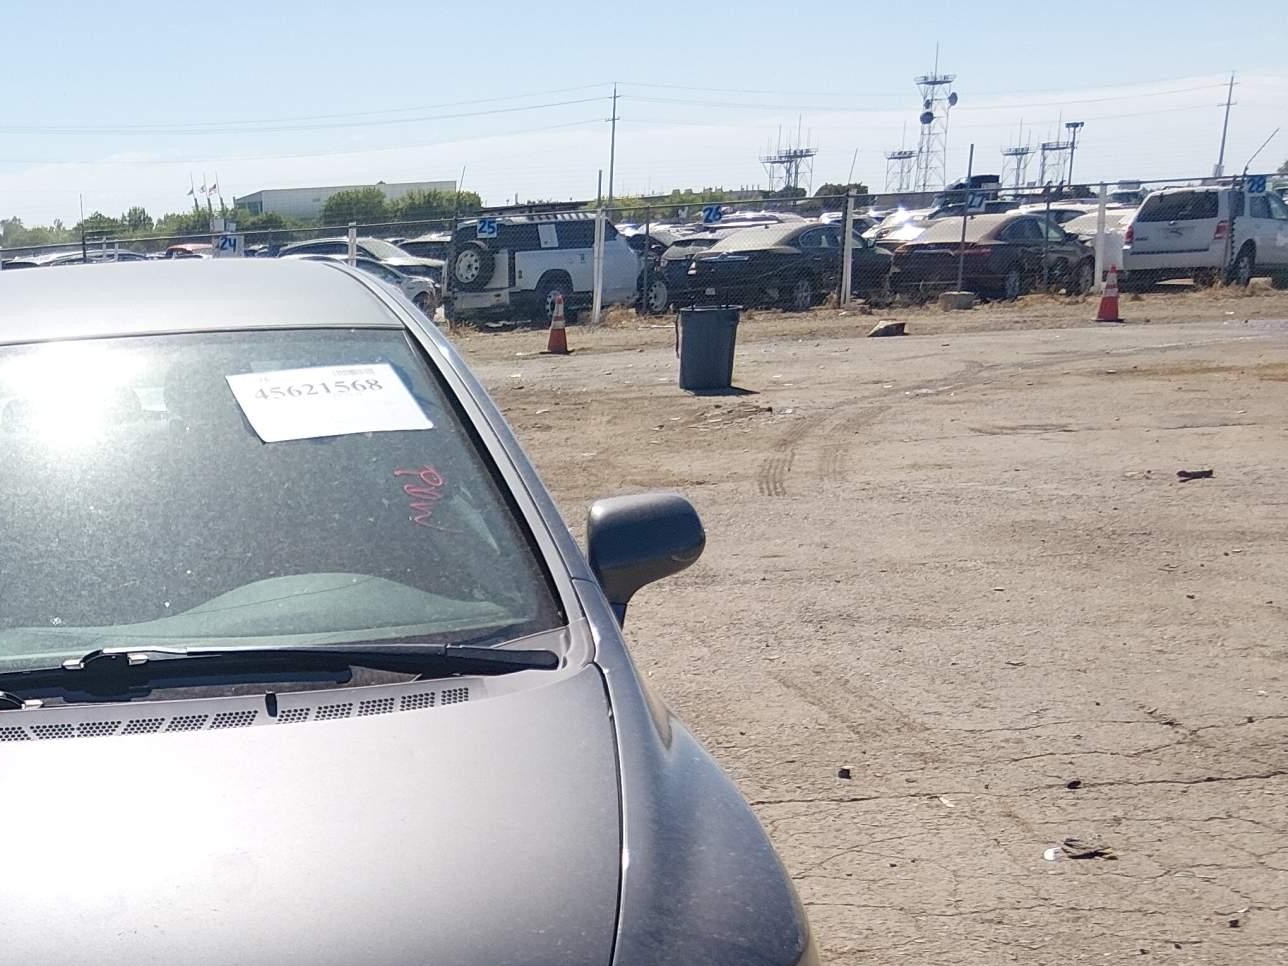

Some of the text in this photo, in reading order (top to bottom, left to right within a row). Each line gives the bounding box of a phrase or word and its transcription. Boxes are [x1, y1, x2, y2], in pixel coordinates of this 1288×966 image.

[1247, 177, 1266, 193] 28
[968, 193, 984, 208] 27
[704, 206, 722, 223] 26
[478, 220, 496, 234] 25
[220, 236, 237, 253] 24
[254, 378, 384, 401] 45621568
